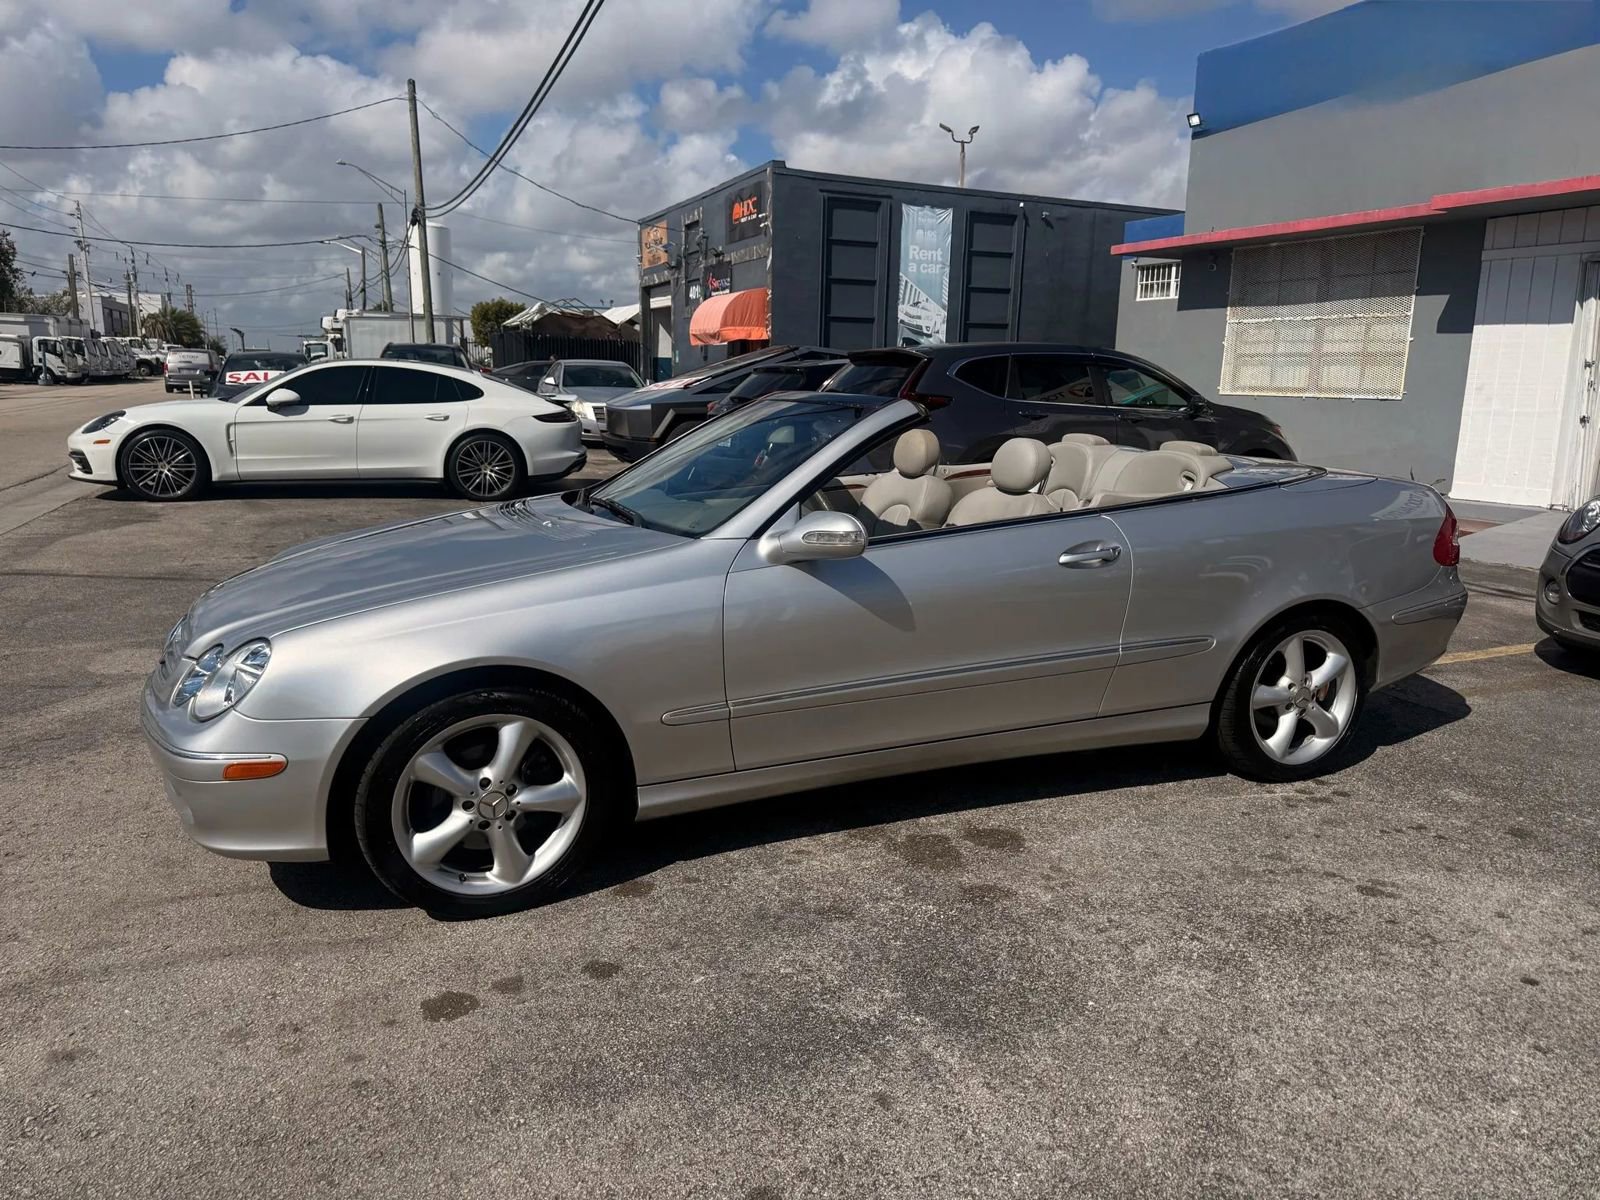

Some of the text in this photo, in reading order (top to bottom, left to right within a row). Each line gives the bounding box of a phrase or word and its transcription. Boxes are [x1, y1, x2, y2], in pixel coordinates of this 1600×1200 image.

[909, 245, 942, 261] Rent
[908, 262, 943, 273] a car
[228, 371, 273, 383] SAL
